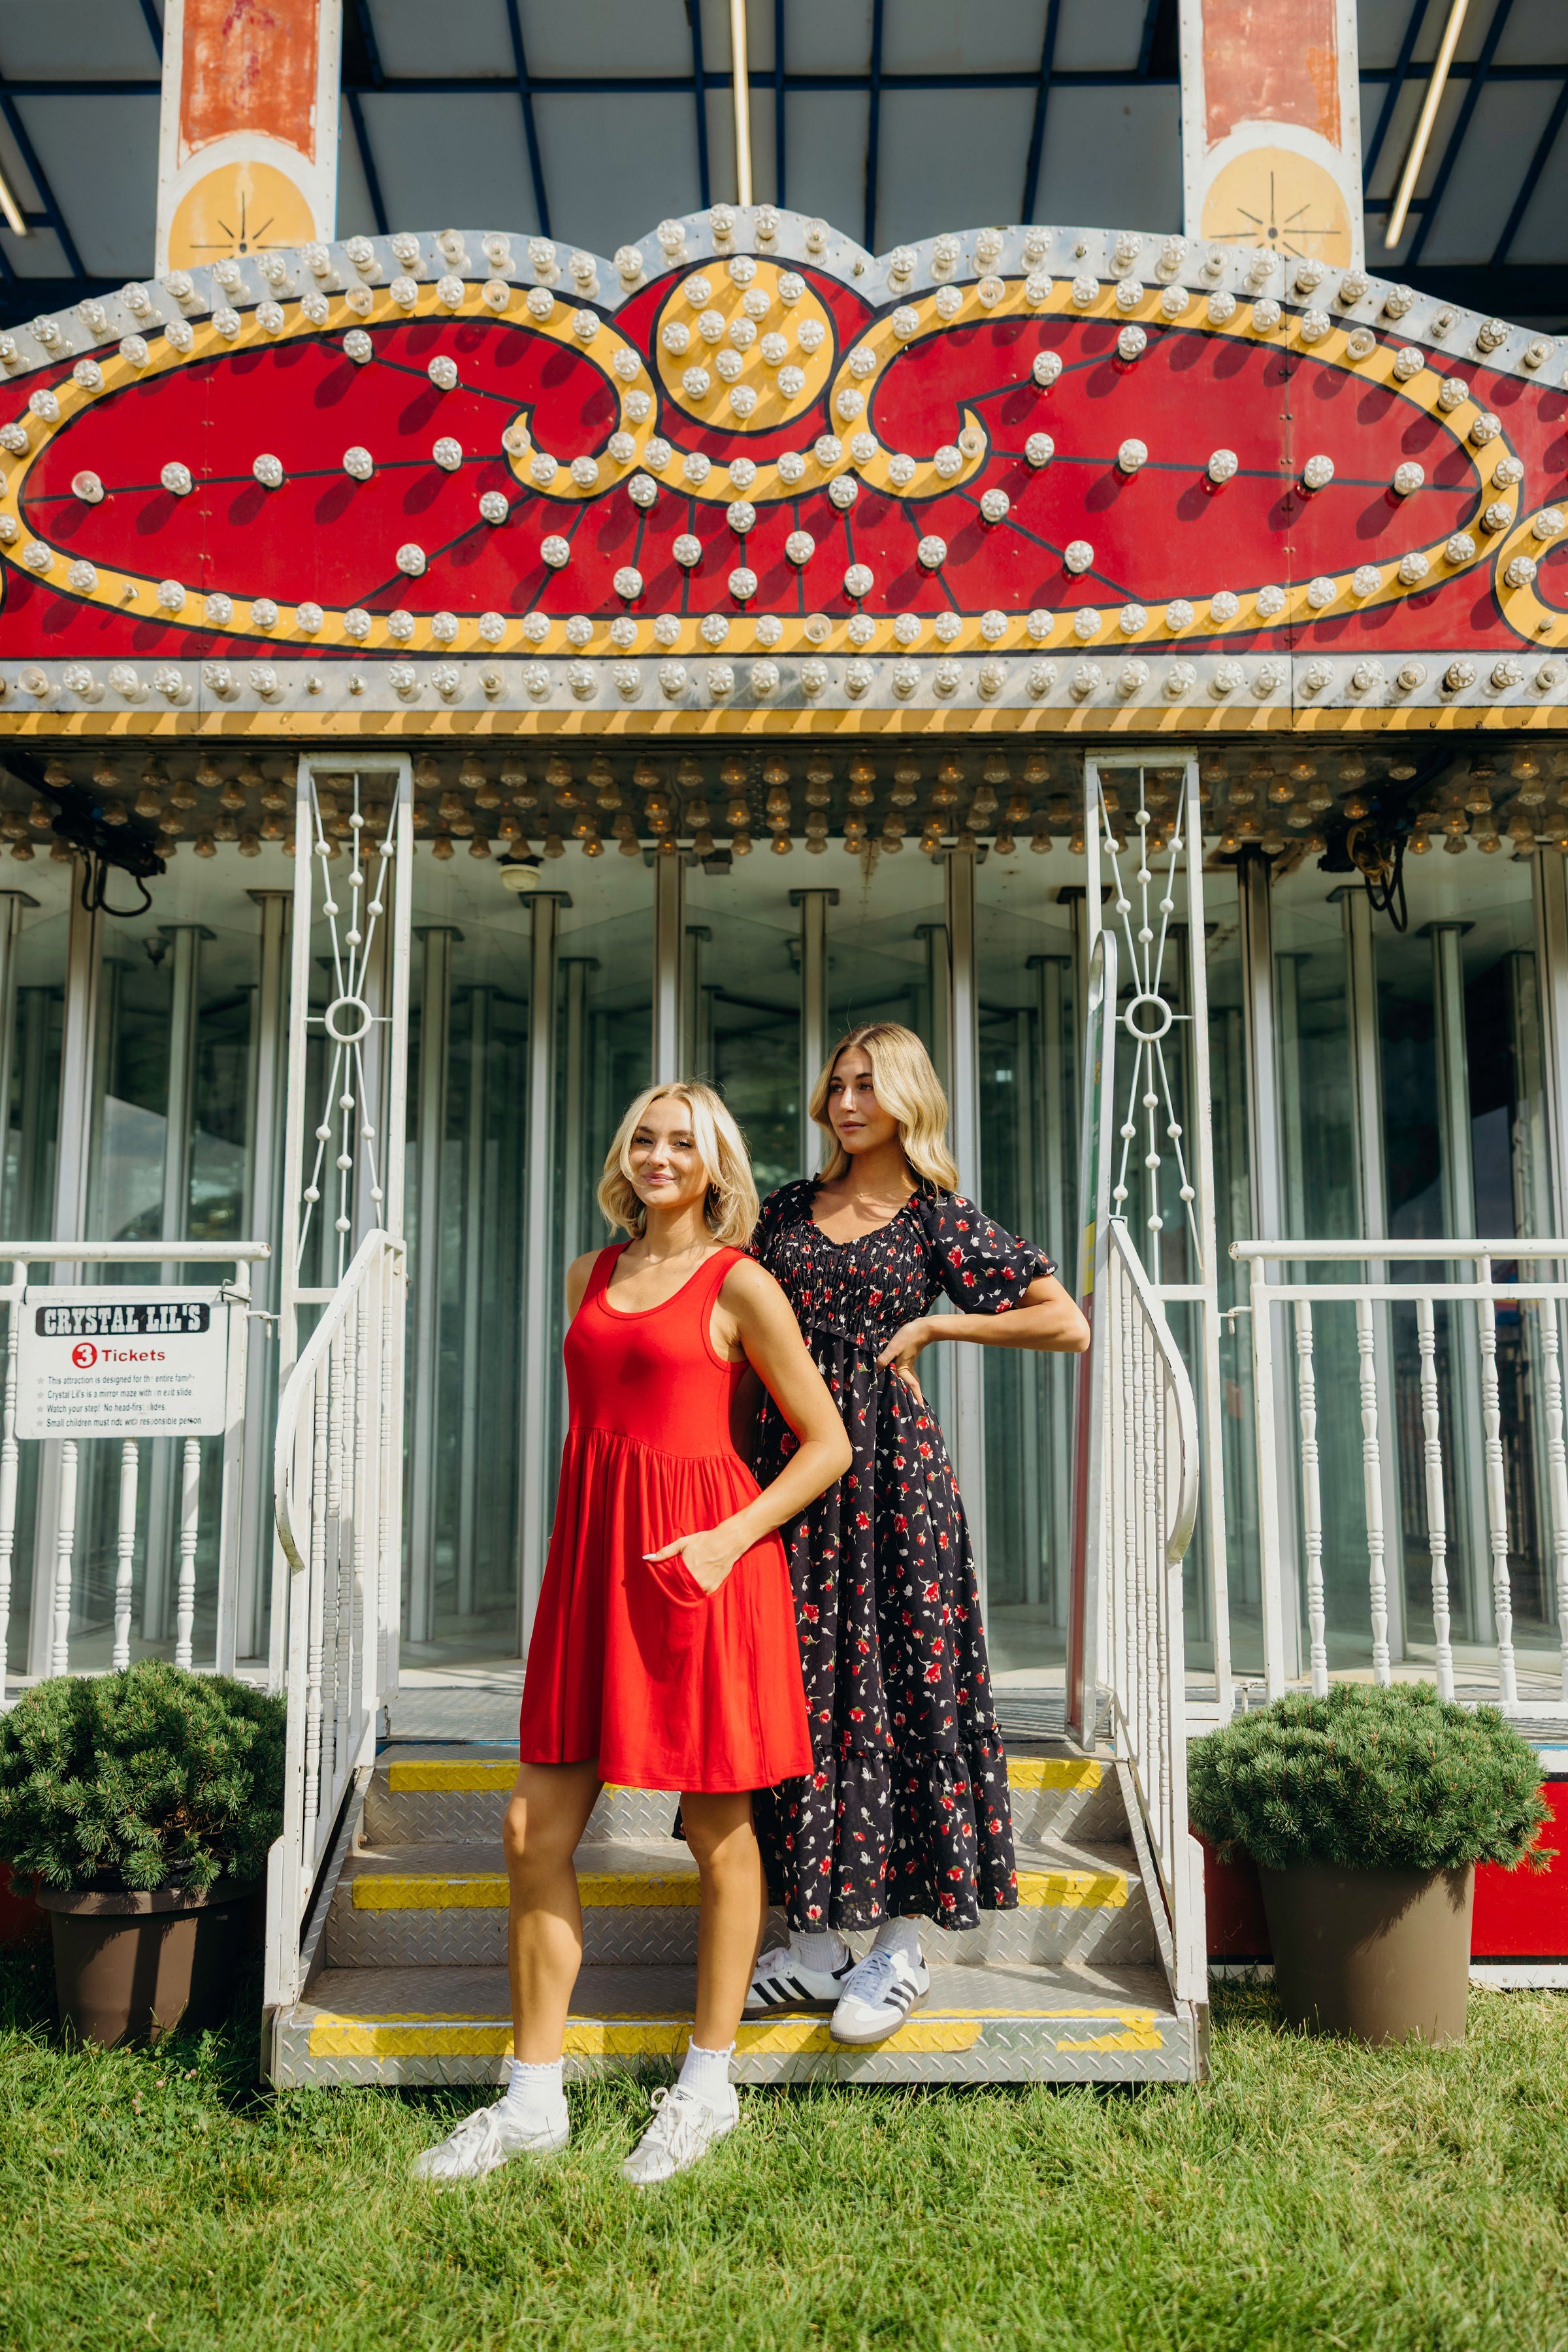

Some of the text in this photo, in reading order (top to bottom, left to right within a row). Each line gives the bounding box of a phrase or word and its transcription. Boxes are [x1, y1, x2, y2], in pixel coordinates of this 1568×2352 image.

[44, 1304, 201, 1335] CRYSTAL LIL'S
[76, 1344, 165, 1367] 3 Tickets
[48, 1376, 61, 1384] This
[63, 1375, 93, 1384] attraction
[103, 1375, 131, 1385] designed
[133, 1375, 142, 1383] for
[155, 1373, 173, 1382] entire
[48, 1390, 69, 1401] Crystal
[86, 1390, 92, 1398] is
[47, 1404, 67, 1413] Watch
[69, 1405, 82, 1414] your
[84, 1404, 100, 1413] step!
[114, 1402, 144, 1411] head-firs
[46, 1418, 65, 1427] Small
[66, 1418, 91, 1427] children
[93, 1418, 110, 1426] must
